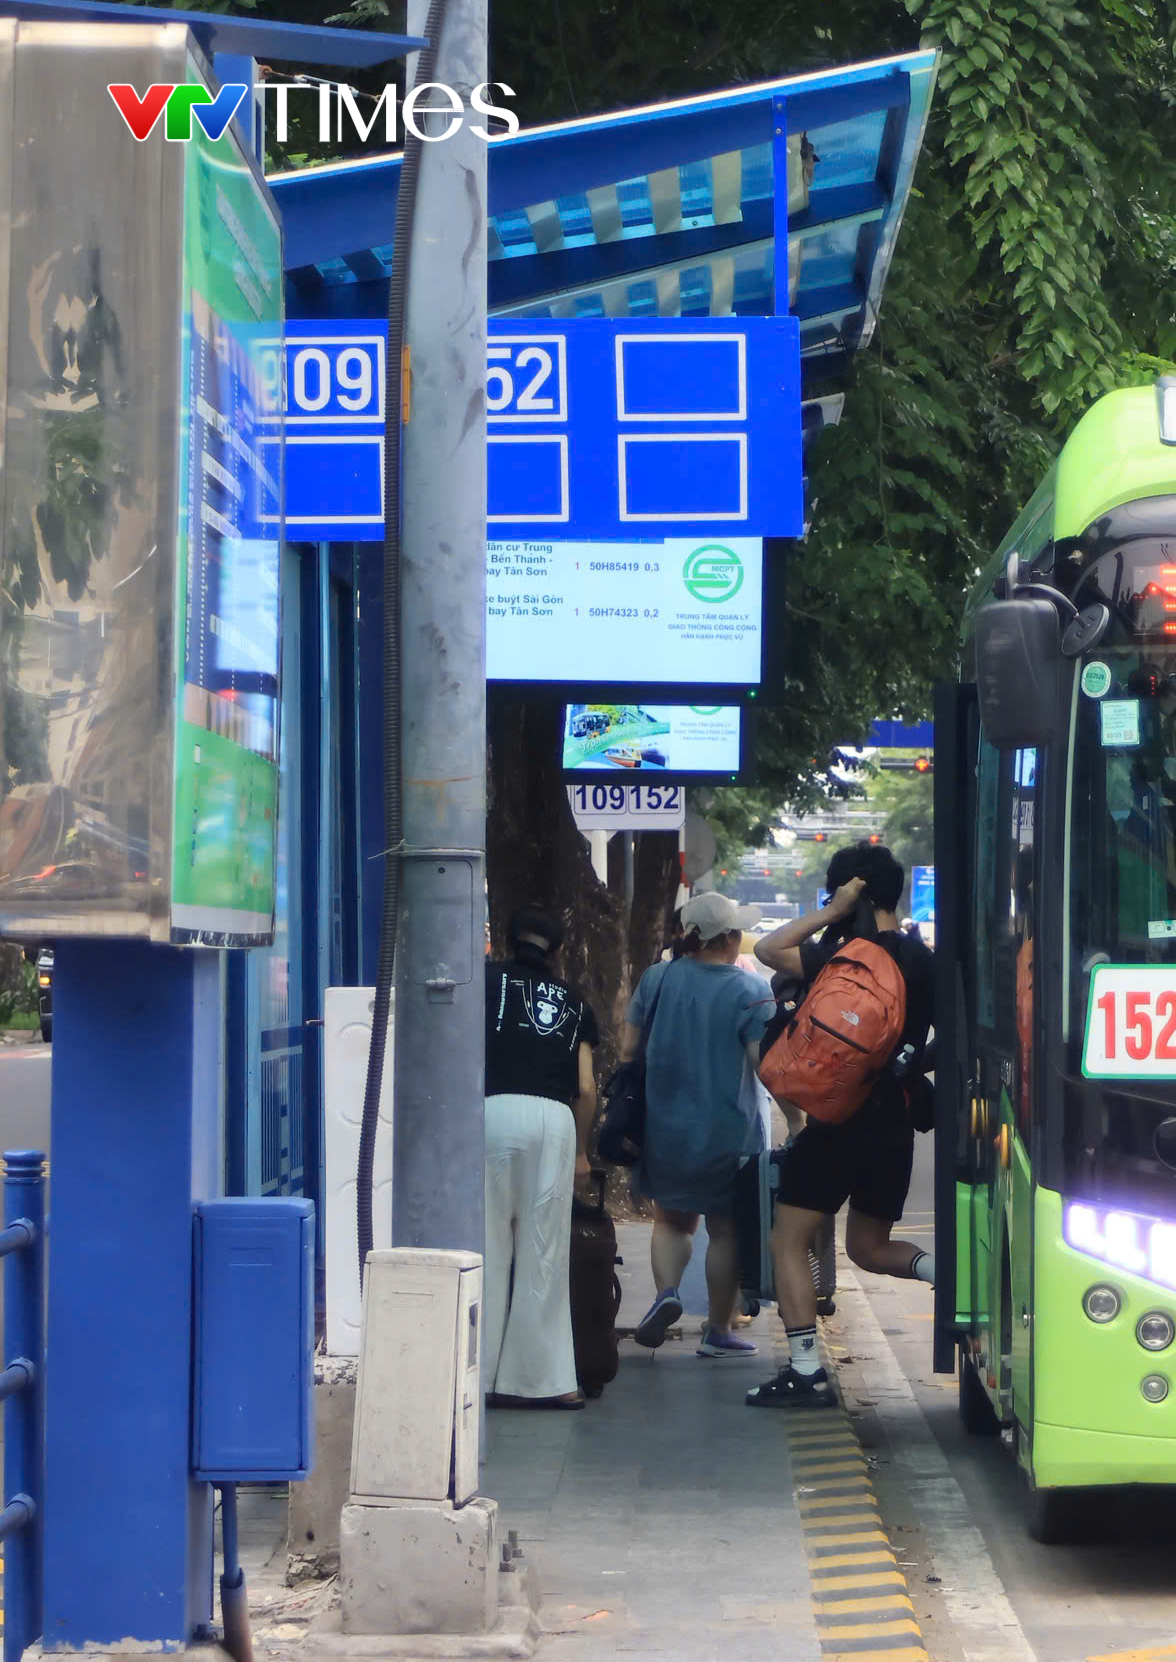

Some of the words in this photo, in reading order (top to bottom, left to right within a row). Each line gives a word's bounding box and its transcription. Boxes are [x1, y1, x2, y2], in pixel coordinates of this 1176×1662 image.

[283, 347, 373, 412] 09
[522, 542, 553, 554] Trung
[525, 566, 548, 576] Sơn
[589, 561, 640, 572] 50H85419
[644, 562, 660, 573] 0,3
[488, 606, 507, 617] bay
[531, 606, 553, 616] Sơn
[588, 607, 639, 618] 50H74323
[643, 608, 659, 619] 0,2
[575, 785, 625, 810] 109
[630, 785, 680, 810] 152
